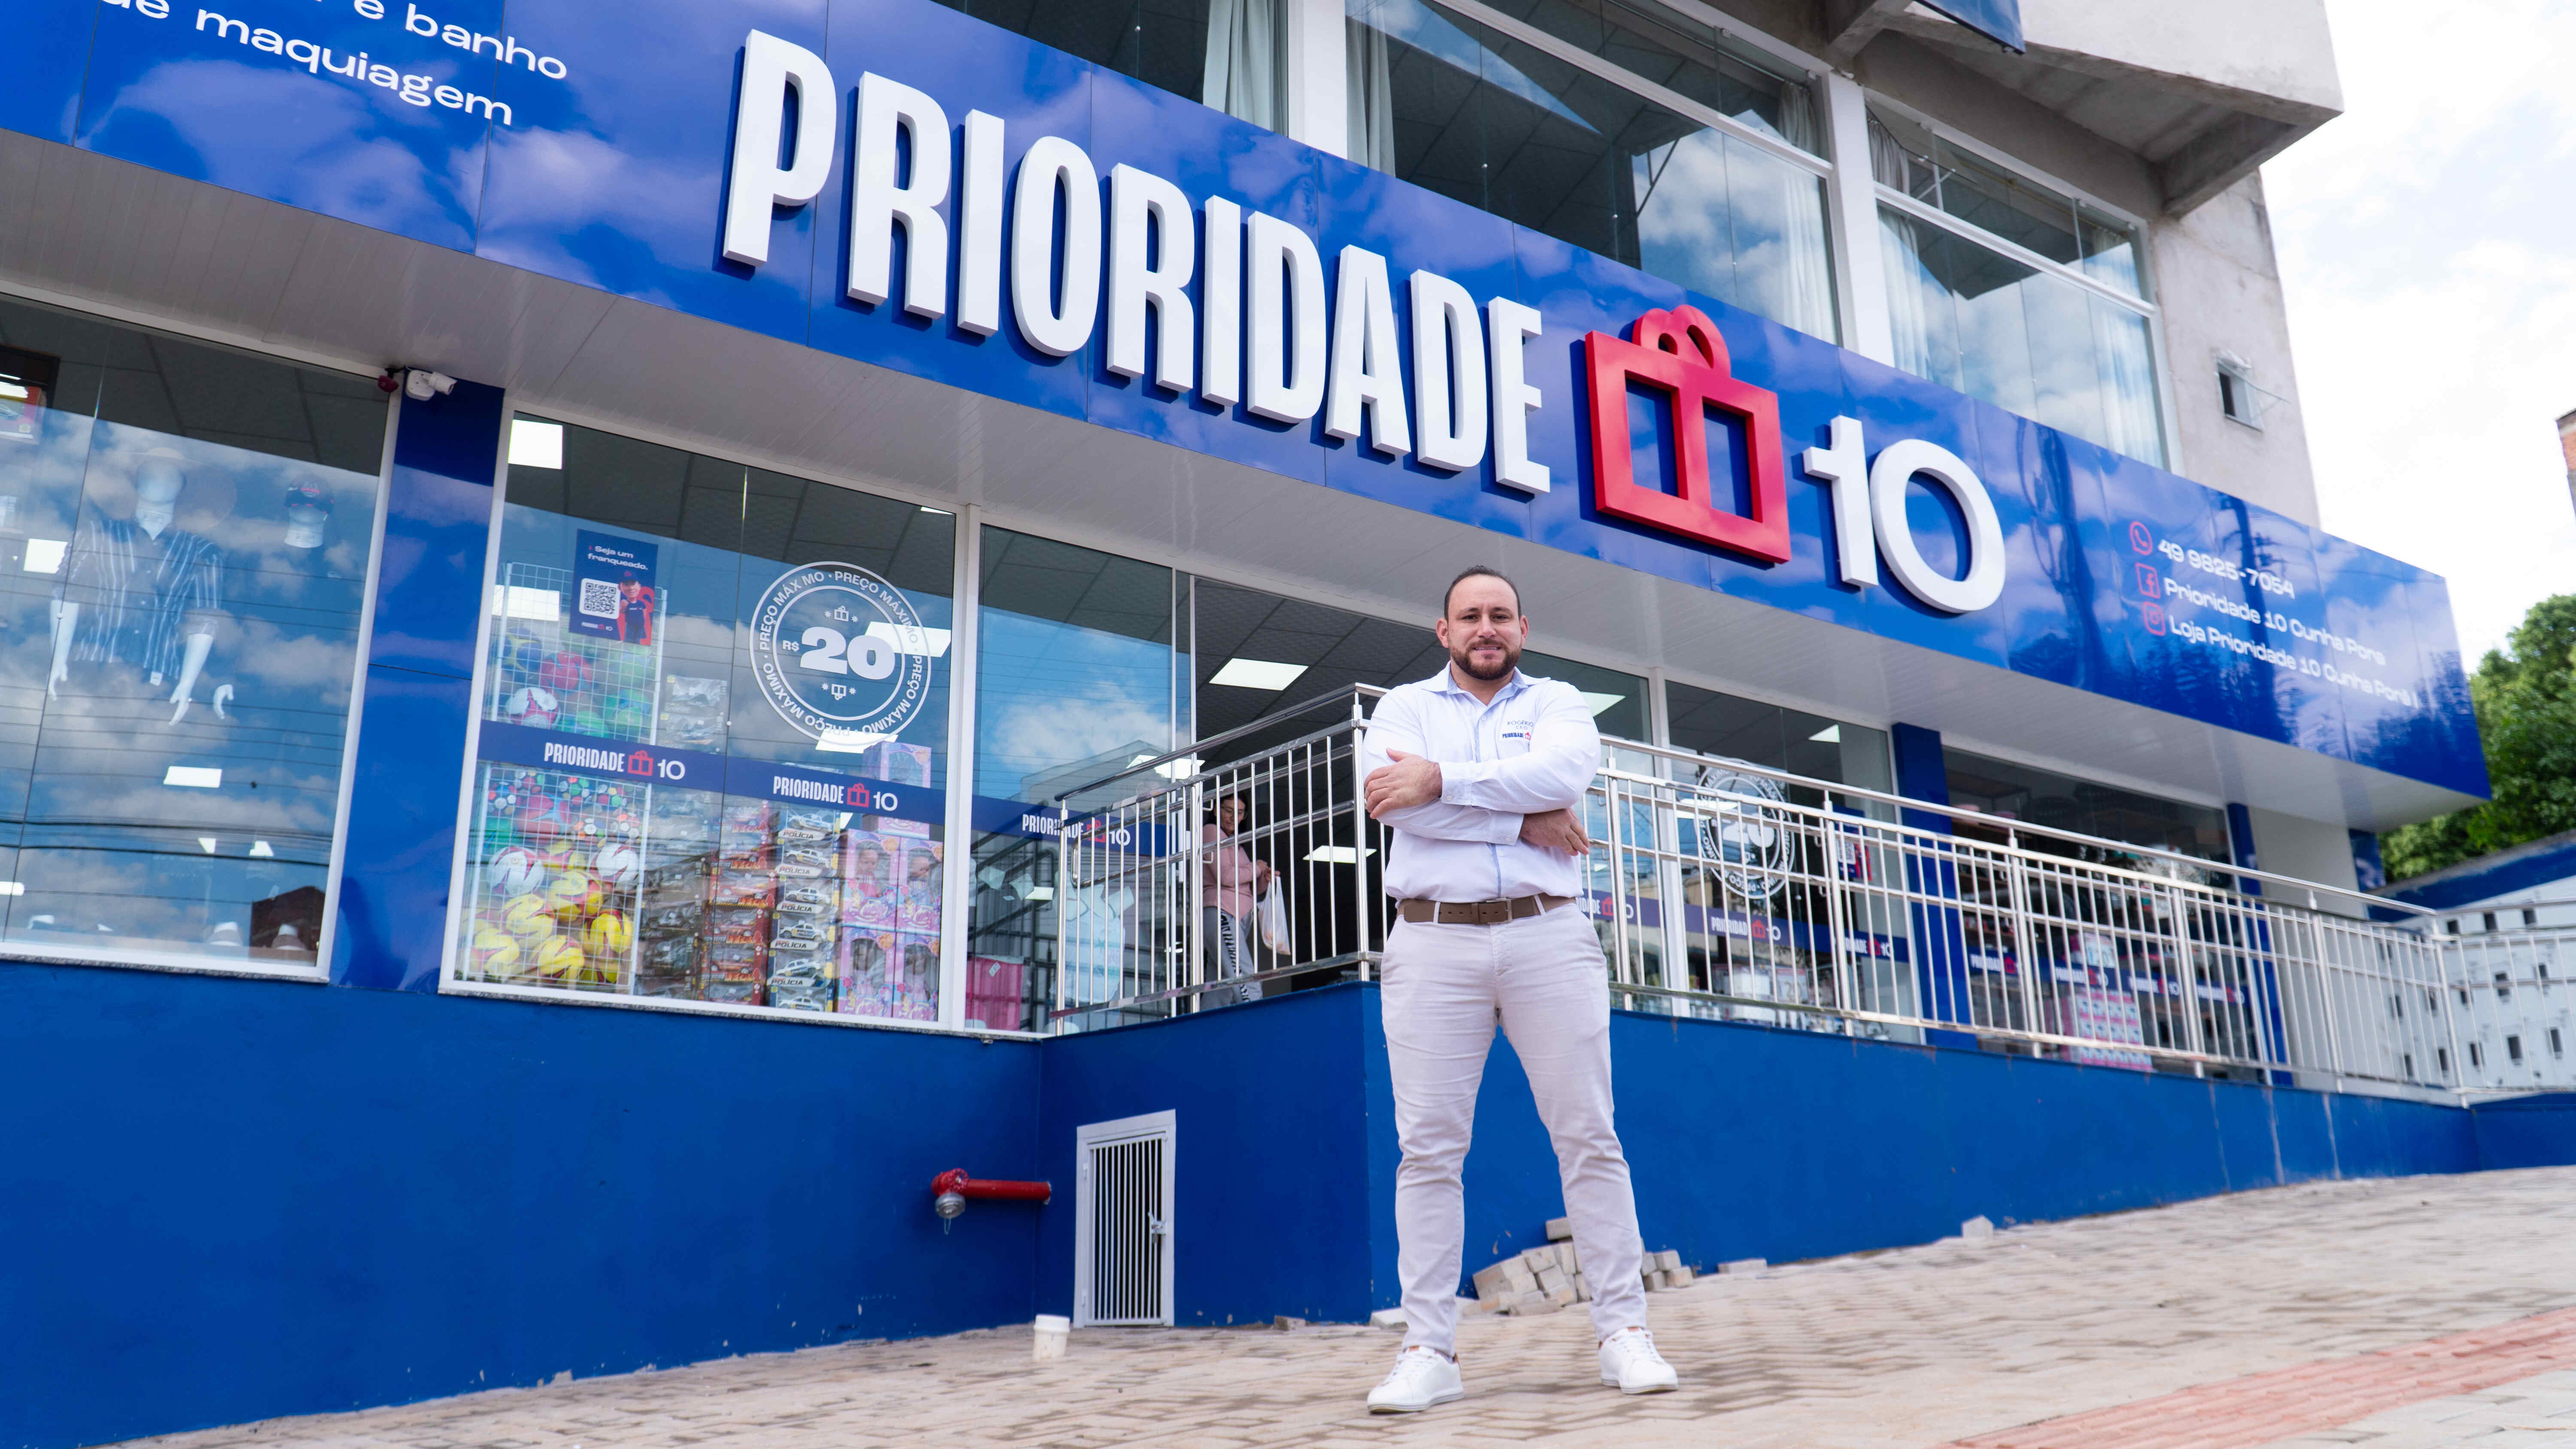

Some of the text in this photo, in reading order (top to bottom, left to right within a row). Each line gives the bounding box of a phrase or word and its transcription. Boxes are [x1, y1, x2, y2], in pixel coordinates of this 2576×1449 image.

[195, 9, 513, 126] maquiagem
[405, 3, 568, 80] banho
[722, 28, 2006, 614] PRIORIDADE 10
[588, 553, 649, 570] franqueado.
[595, 546, 616, 555] Seja
[2158, 539, 2295, 599] 49 9825-7054
[759, 605, 777, 651] PREÇO
[835, 571, 918, 644] PREÇO MÁXIMO
[2164, 577, 2261, 624] Prioridade
[2264, 610, 2287, 633] 10
[2289, 618, 2345, 652] Cunha
[782, 627, 896, 680] R$ 20
[2169, 614, 2207, 644] Loja
[2207, 626, 2297, 670] Prioridade
[2299, 655, 2321, 677] 10
[763, 663, 804, 719] MÁXIMO
[862, 655, 922, 735] PREÇO MÁXIMO
[544, 743, 686, 780] PRIORIDADE 10
[773, 776, 898, 811] PRIORIDADE 10
